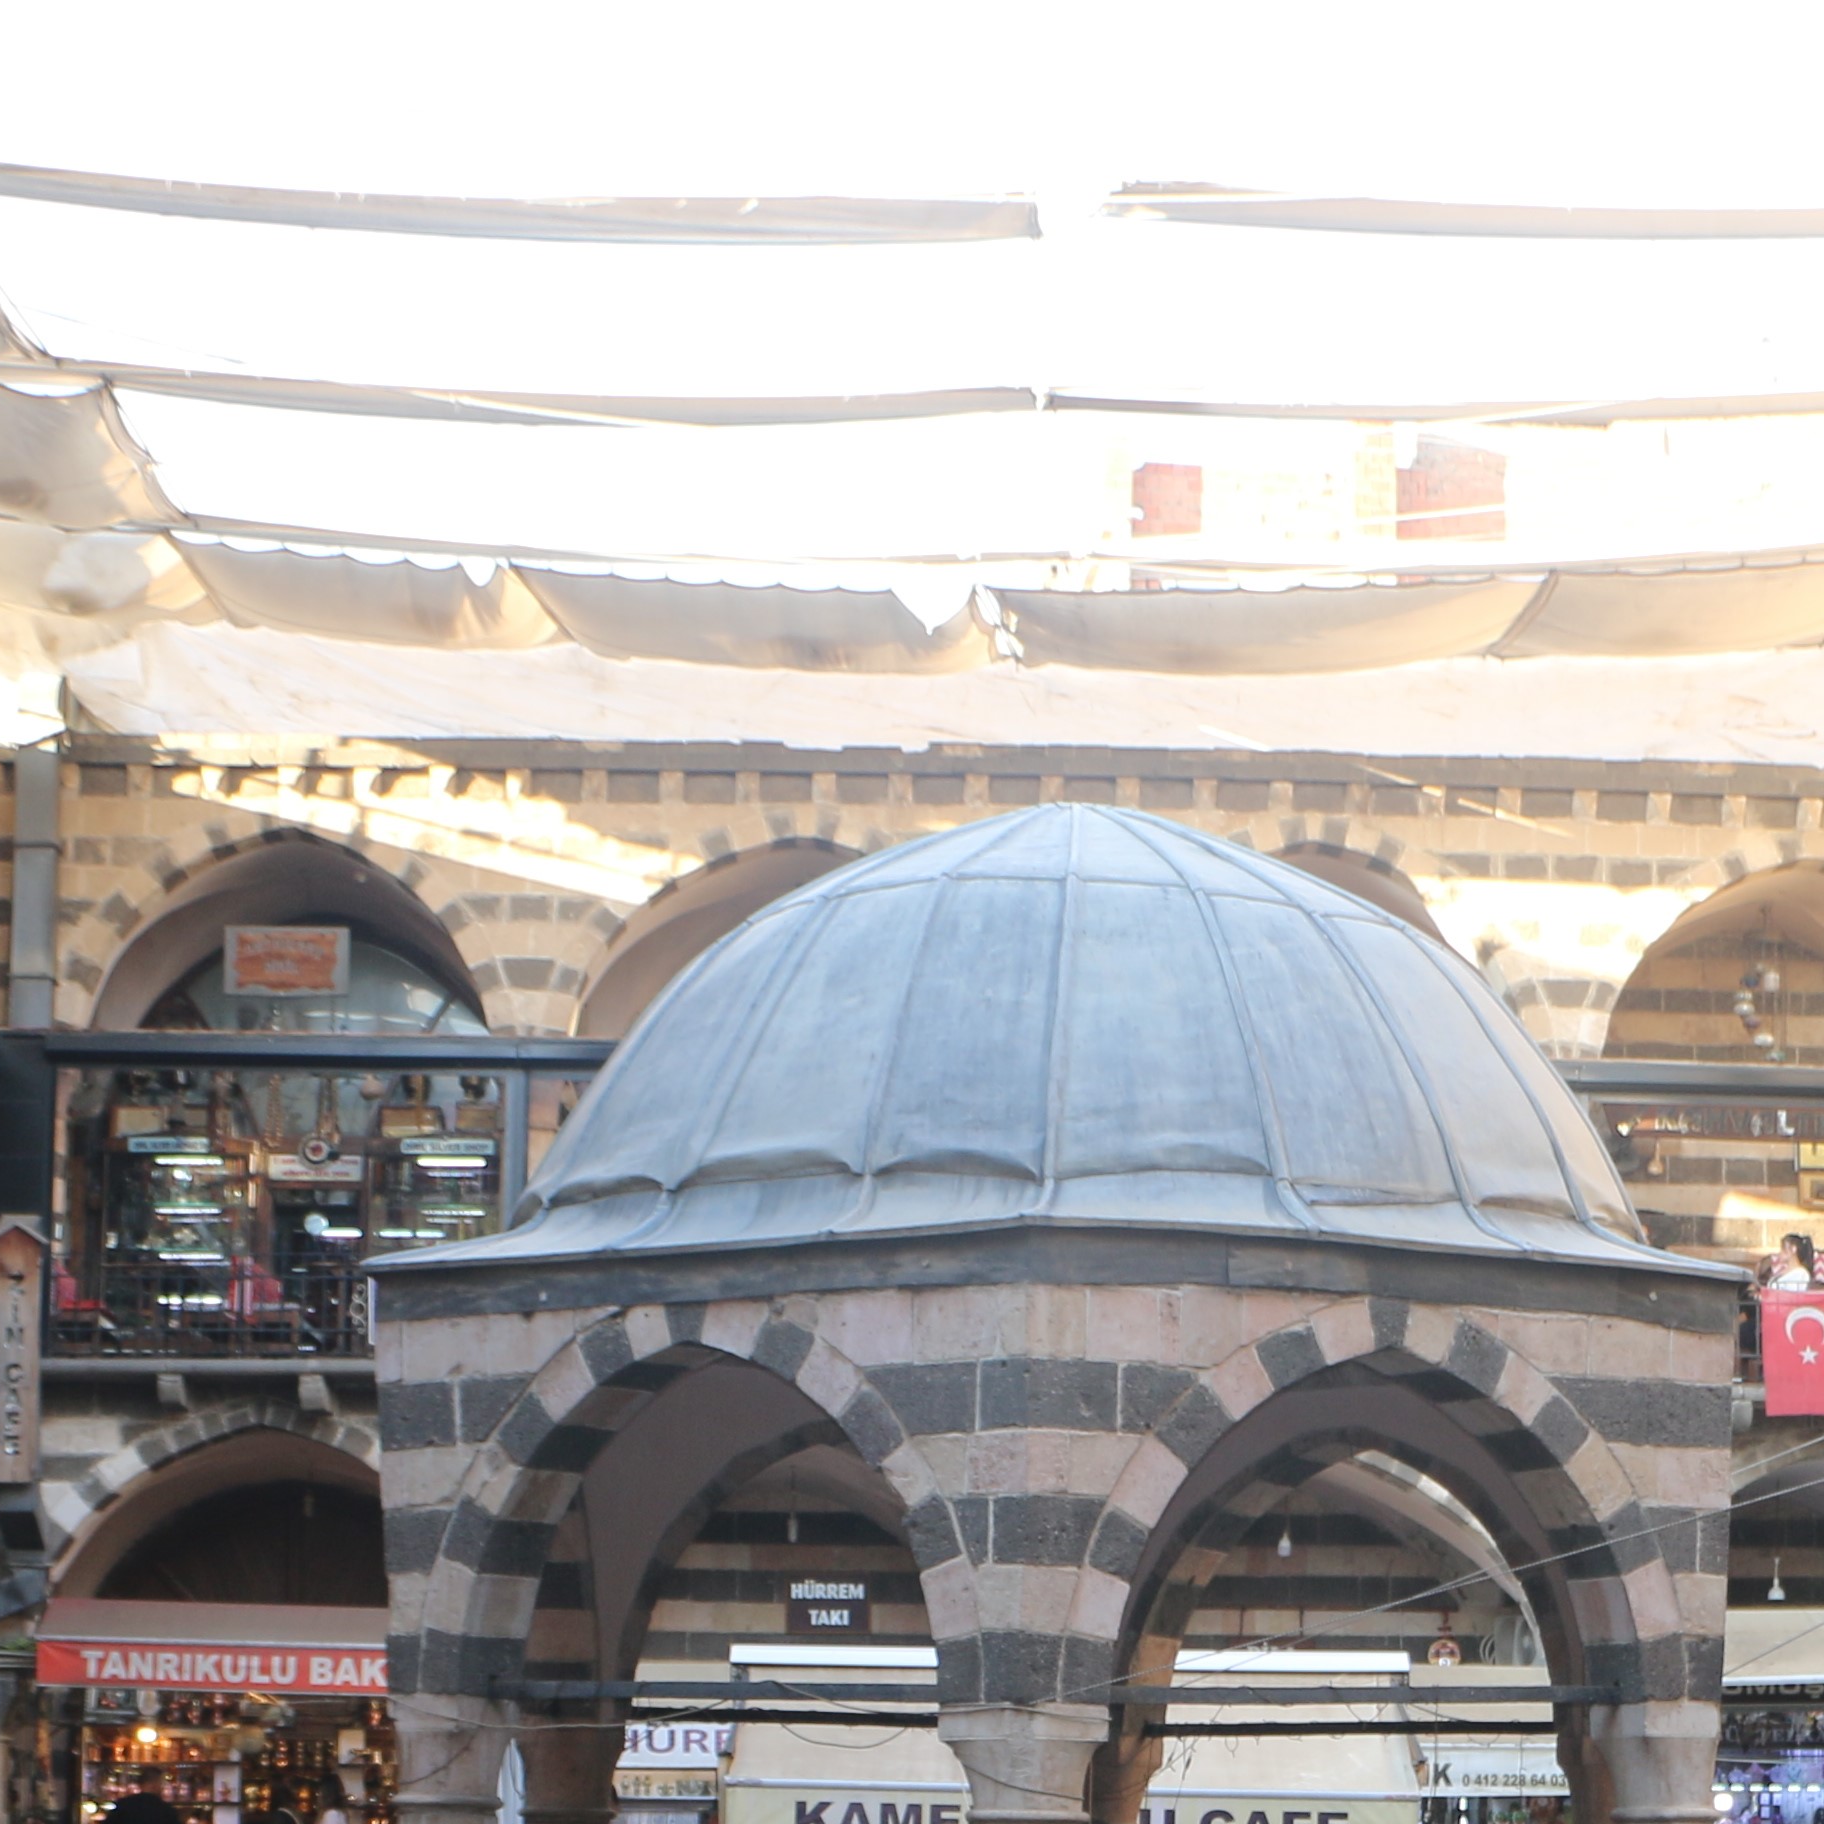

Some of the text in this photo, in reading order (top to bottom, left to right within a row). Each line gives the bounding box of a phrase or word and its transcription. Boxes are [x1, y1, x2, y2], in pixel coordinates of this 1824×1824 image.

[790, 1580, 865, 1601] HÜRREM
[808, 1609, 850, 1627] TAKI
[81, 1650, 388, 1687] TANRIKULU BAK
[1475, 1774, 1499, 1787] 412
[1503, 1774, 1526, 1787] 228
[1530, 1774, 1546, 1787] 64
